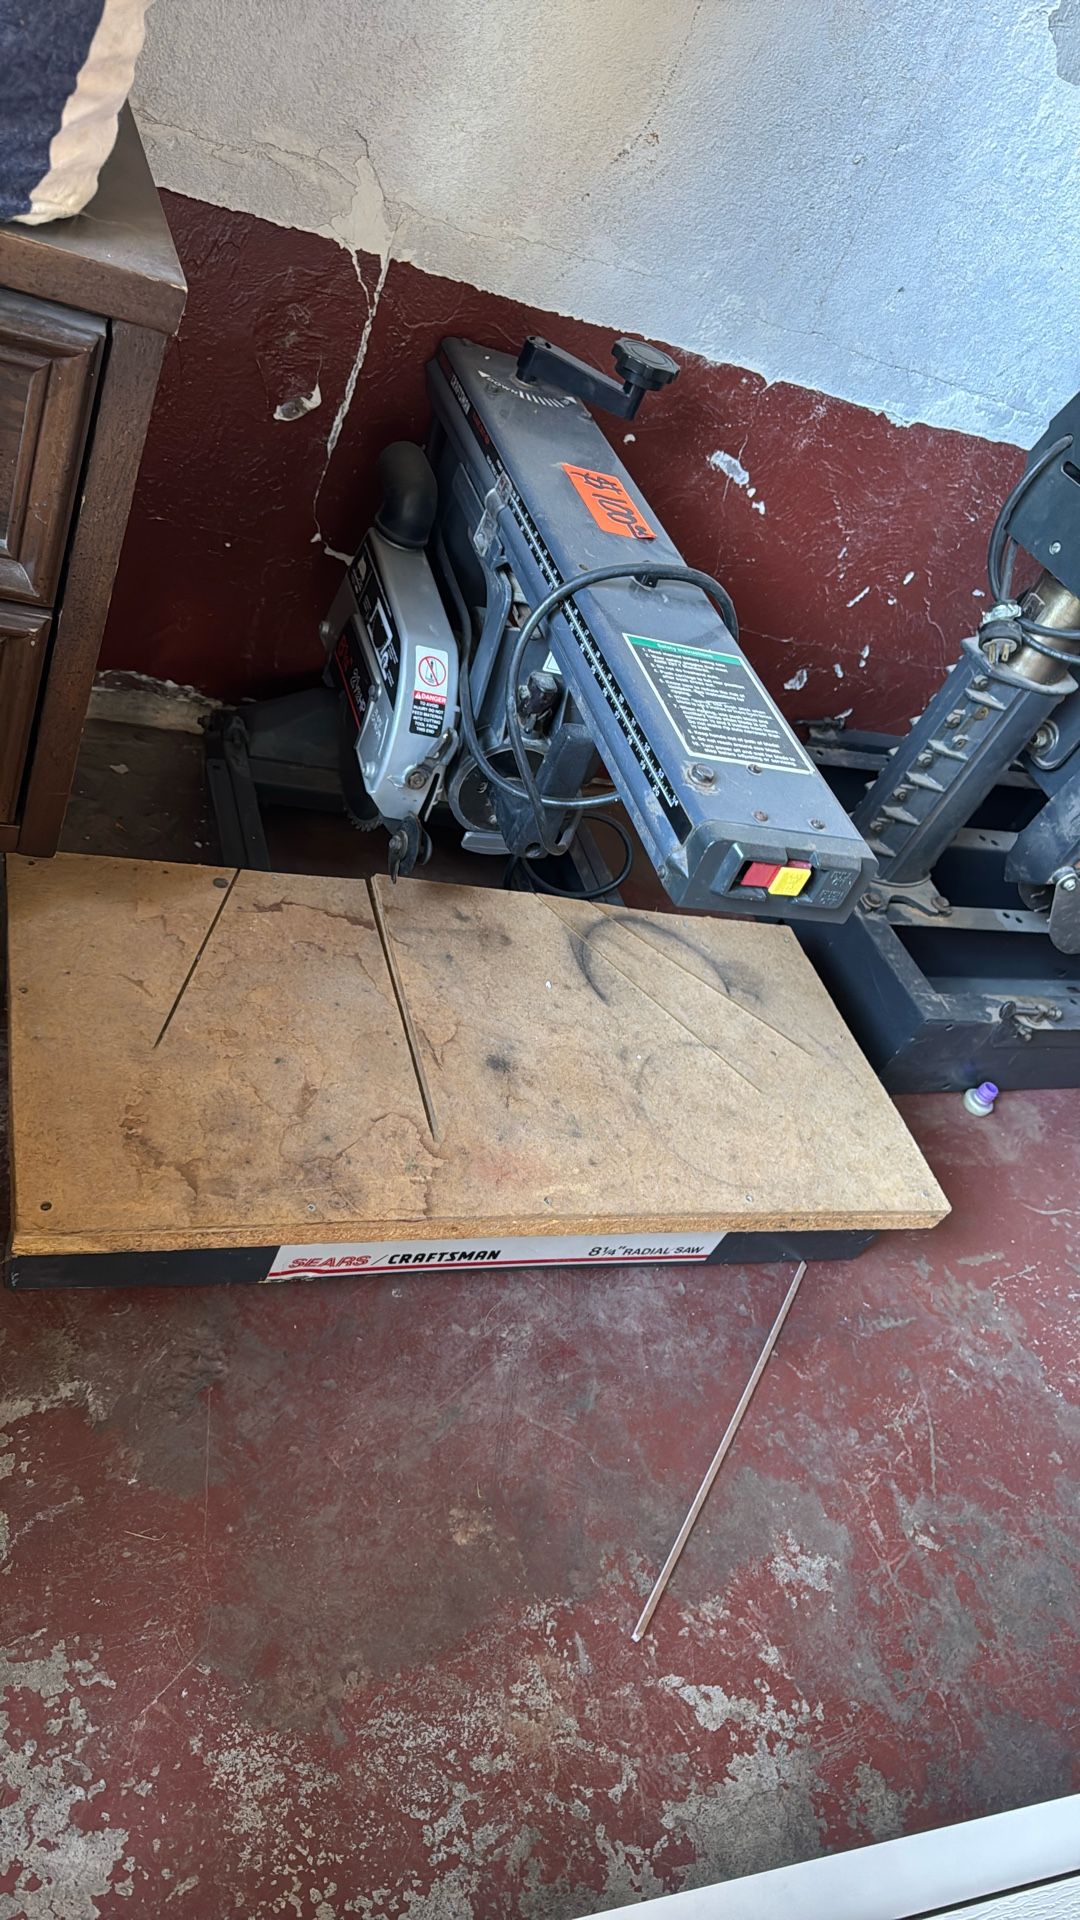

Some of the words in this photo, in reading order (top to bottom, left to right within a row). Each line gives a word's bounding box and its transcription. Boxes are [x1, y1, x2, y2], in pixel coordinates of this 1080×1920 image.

[421, 692, 447, 704] DANGER
[623, 1248, 670, 1256] RADIAL
[674, 1246, 704, 1254] SAW
[288, 1255, 372, 1268] SEARS
[388, 1250, 501, 1264] CRAFTSMAN
